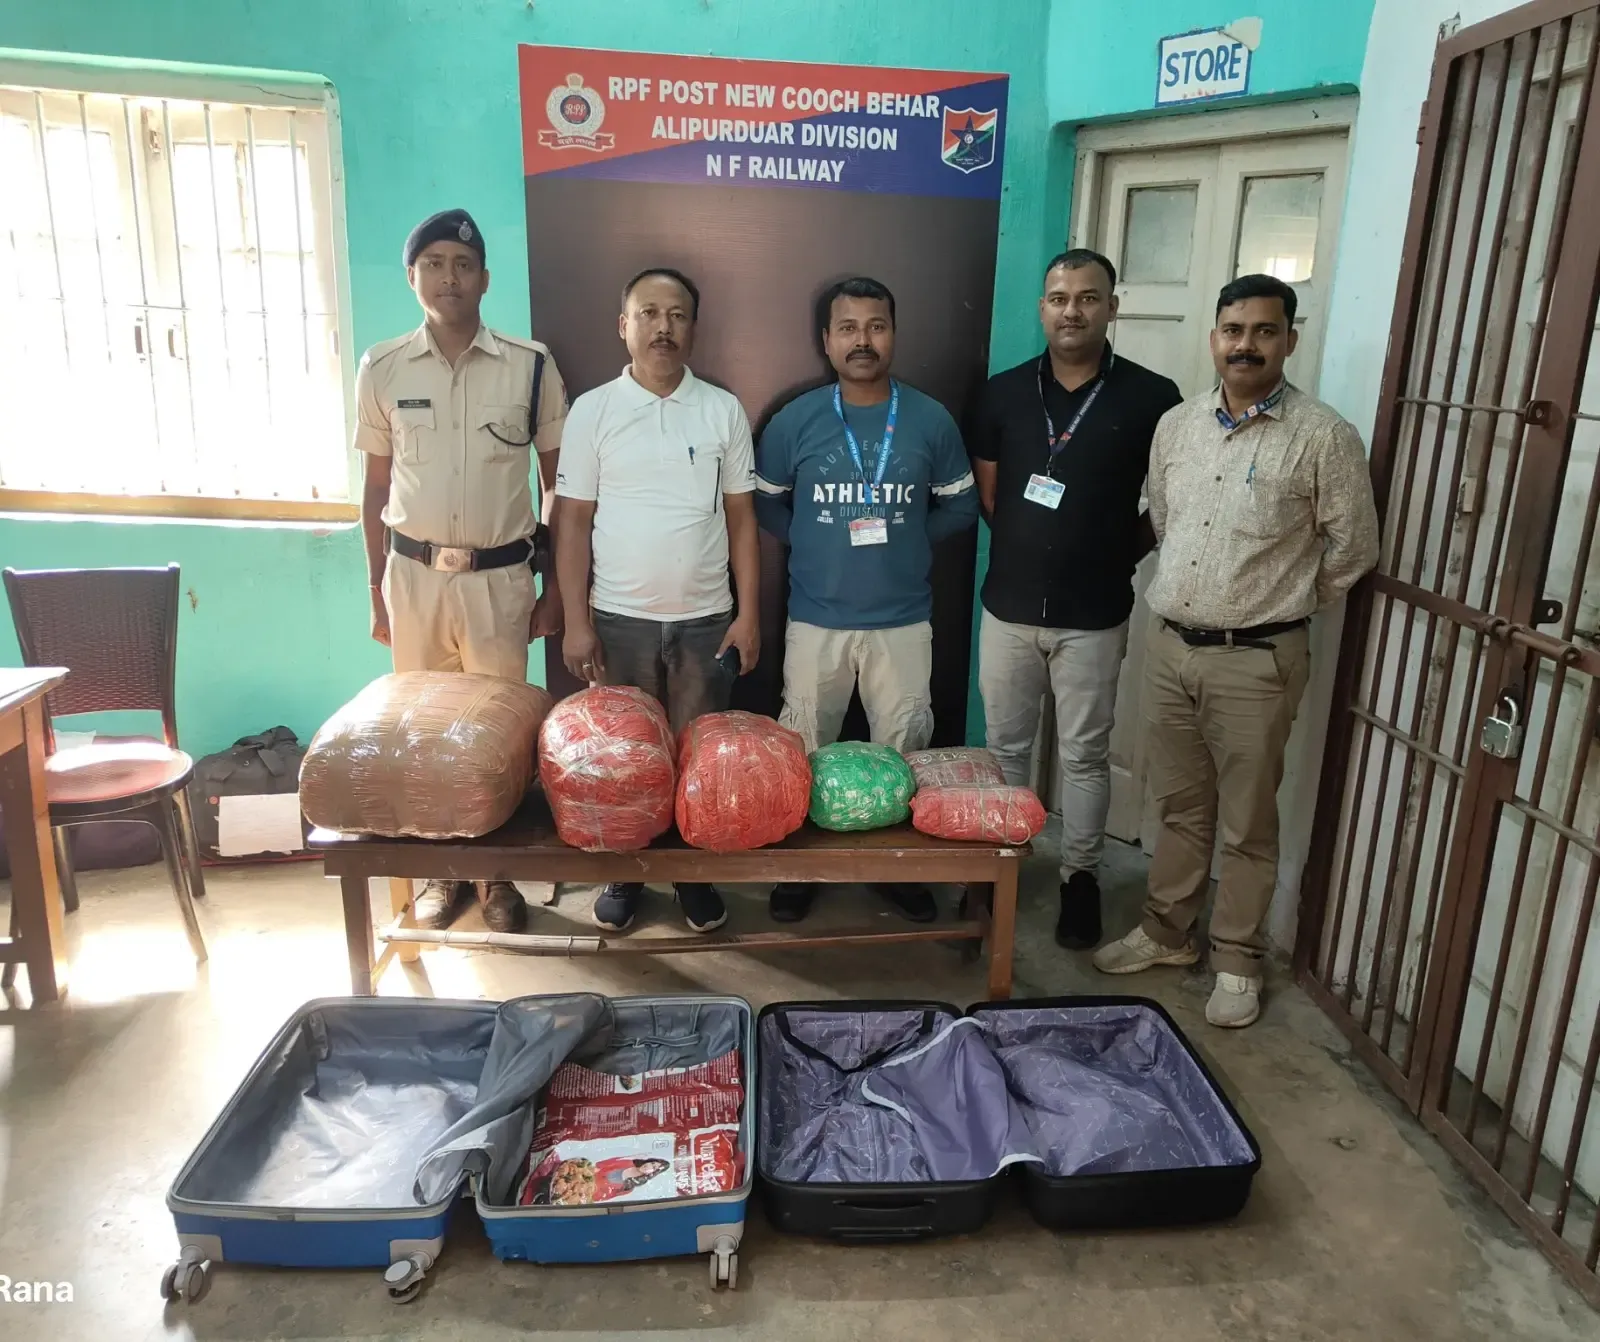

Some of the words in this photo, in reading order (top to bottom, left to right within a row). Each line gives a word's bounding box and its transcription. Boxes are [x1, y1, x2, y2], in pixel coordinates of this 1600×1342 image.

[1163, 43, 1243, 87] STORE
[608, 76, 652, 102] RPF
[658, 79, 719, 106] POST
[725, 83, 776, 109] NEW
[782, 87, 859, 113] COOCH
[866, 91, 940, 118] BEHAR
[652, 116, 795, 145] ALIPURDUAR
[801, 124, 898, 151] DIVISION
[706, 154, 722, 177] N
[729, 156, 742, 178] F
[748, 157, 844, 183] RAILWAY
[818, 440, 908, 476] AUTENTIC
[813, 483, 915, 504] ATHLETIC
